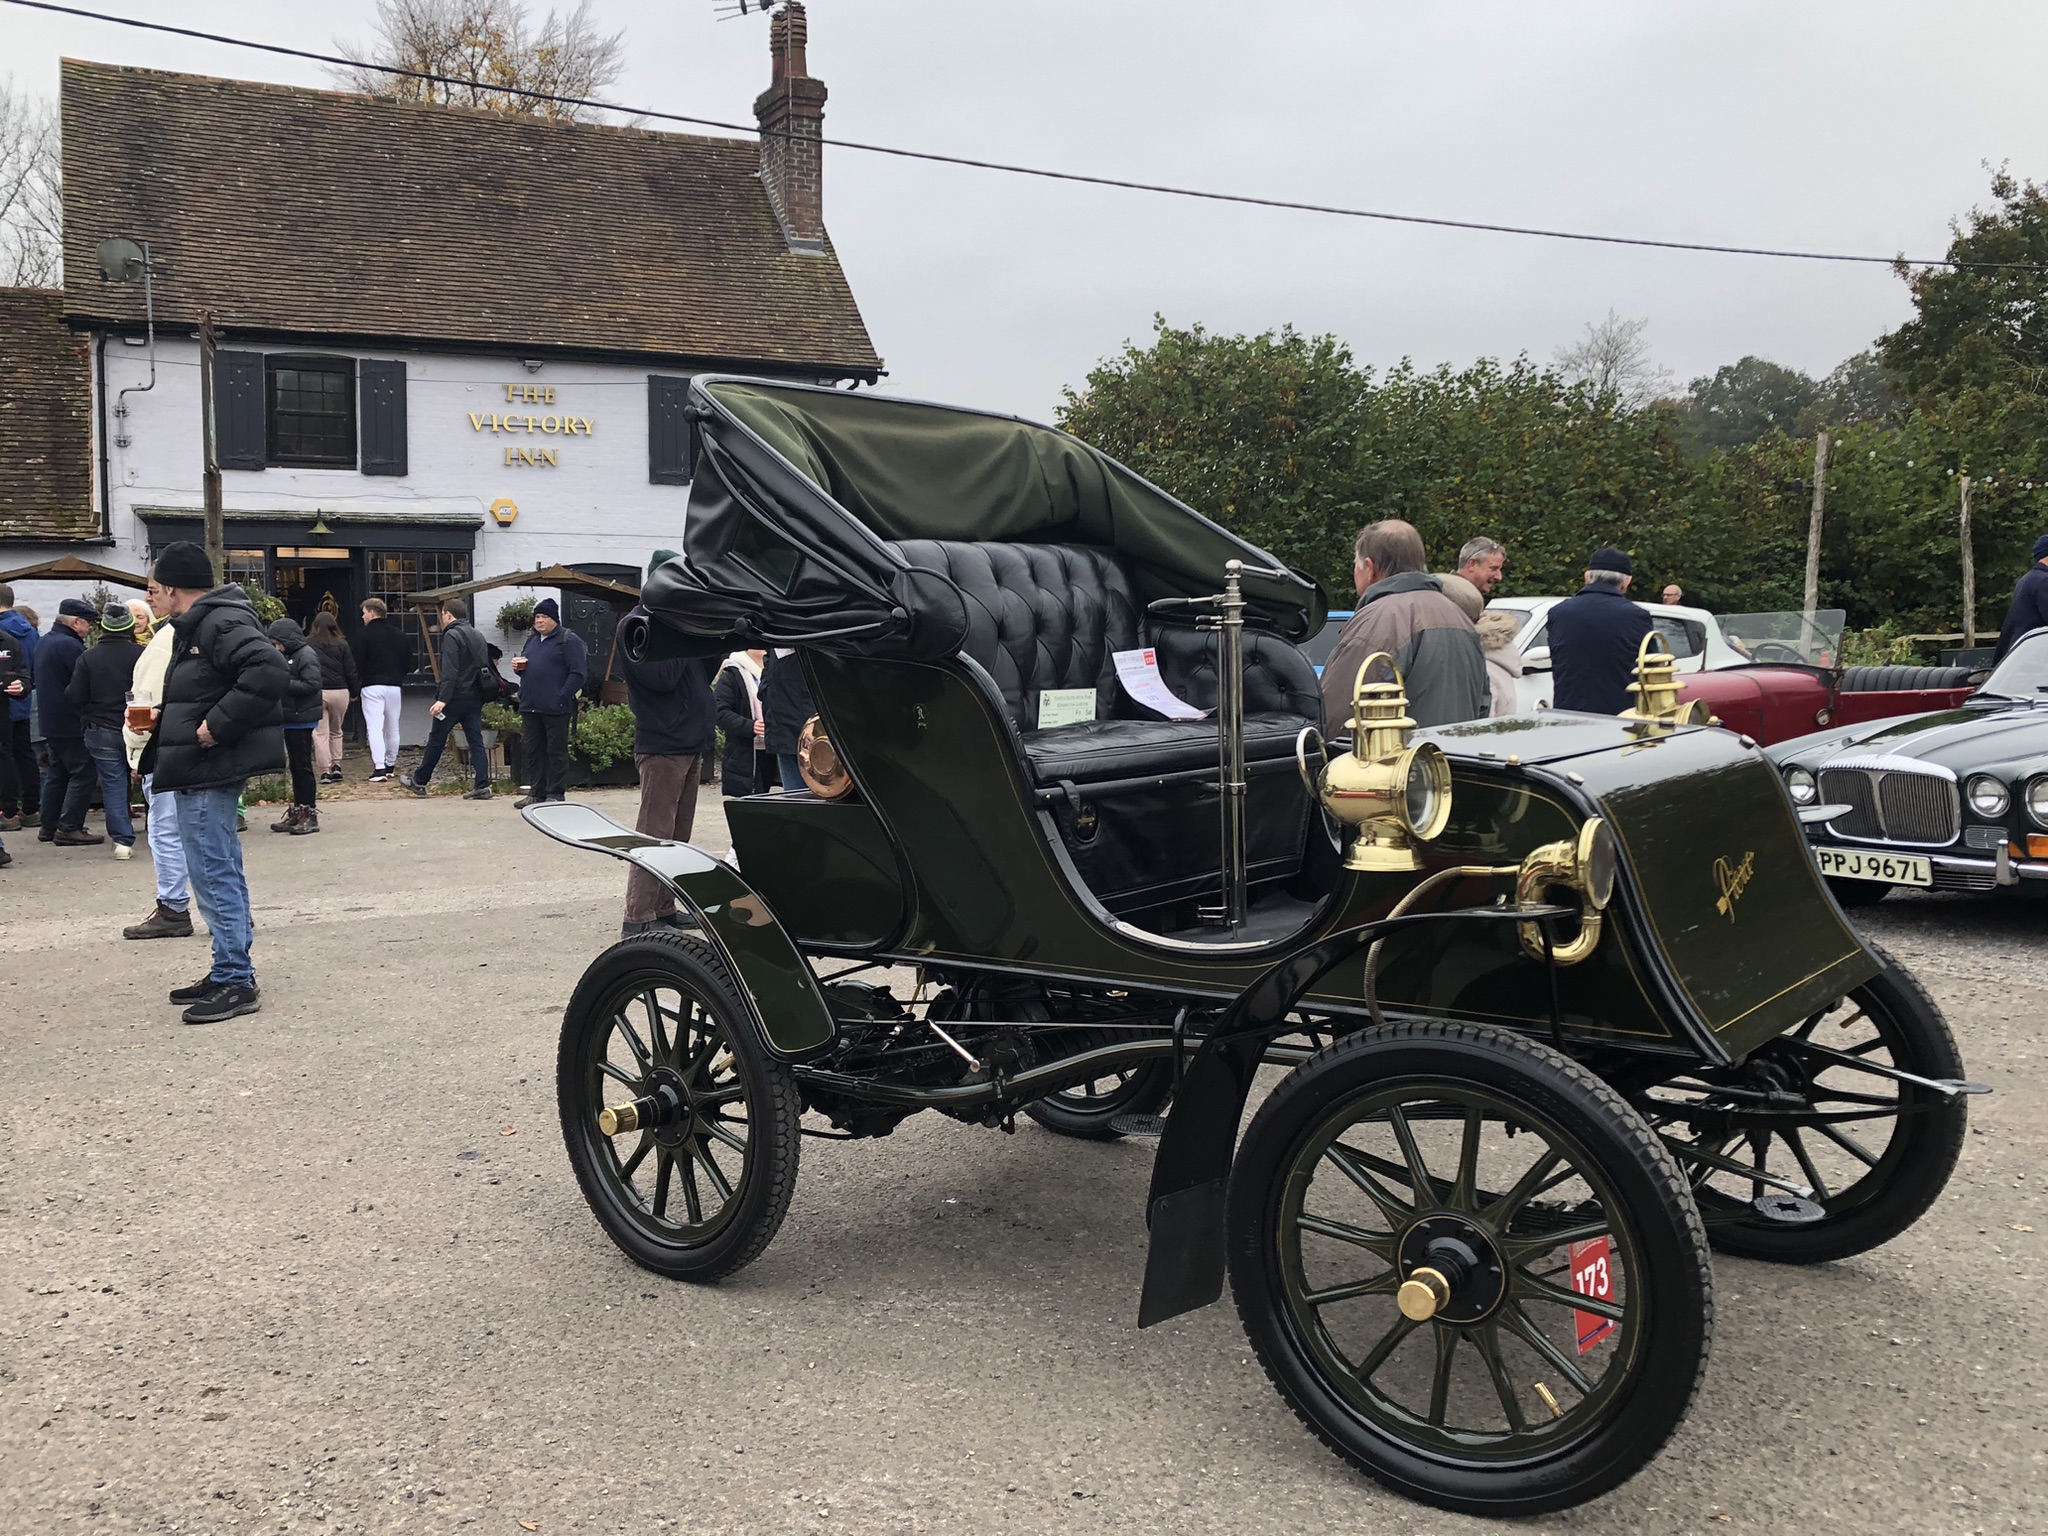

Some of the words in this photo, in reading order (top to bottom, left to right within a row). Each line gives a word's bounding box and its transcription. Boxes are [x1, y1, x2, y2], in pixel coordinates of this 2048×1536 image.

[503, 383, 555, 403] THE
[469, 413, 594, 434] VICTORY
[504, 447, 558, 467] INN
[1576, 1257, 1608, 1297] 173
